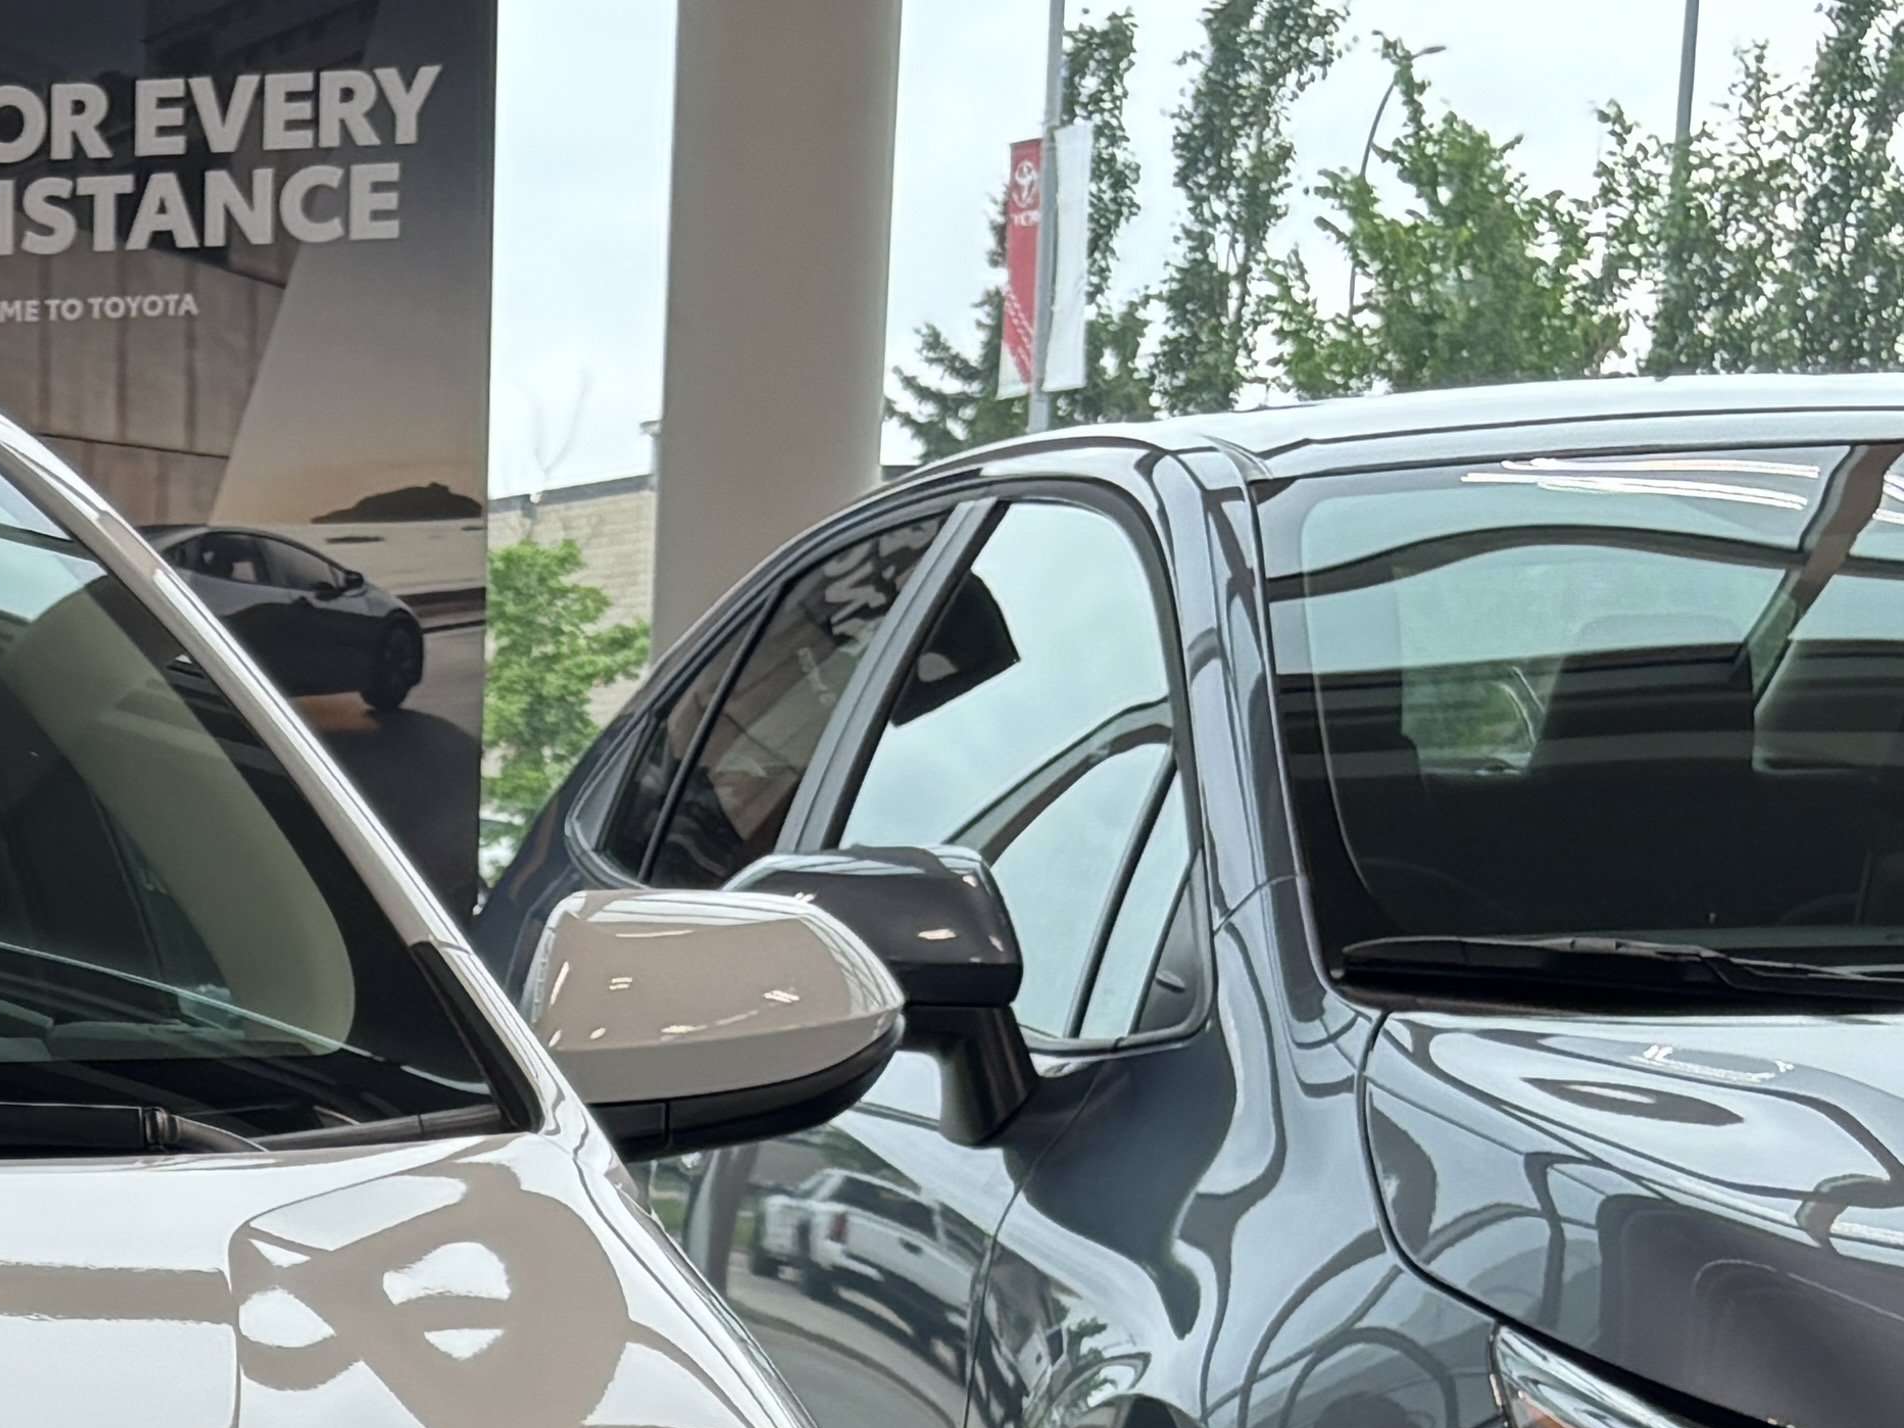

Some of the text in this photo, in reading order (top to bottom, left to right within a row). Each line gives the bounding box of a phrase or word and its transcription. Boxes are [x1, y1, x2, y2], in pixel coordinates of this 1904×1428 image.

[134, 64, 442, 158] EVERY
[44, 297, 84, 322] TO
[87, 292, 200, 320] TOYOTA
